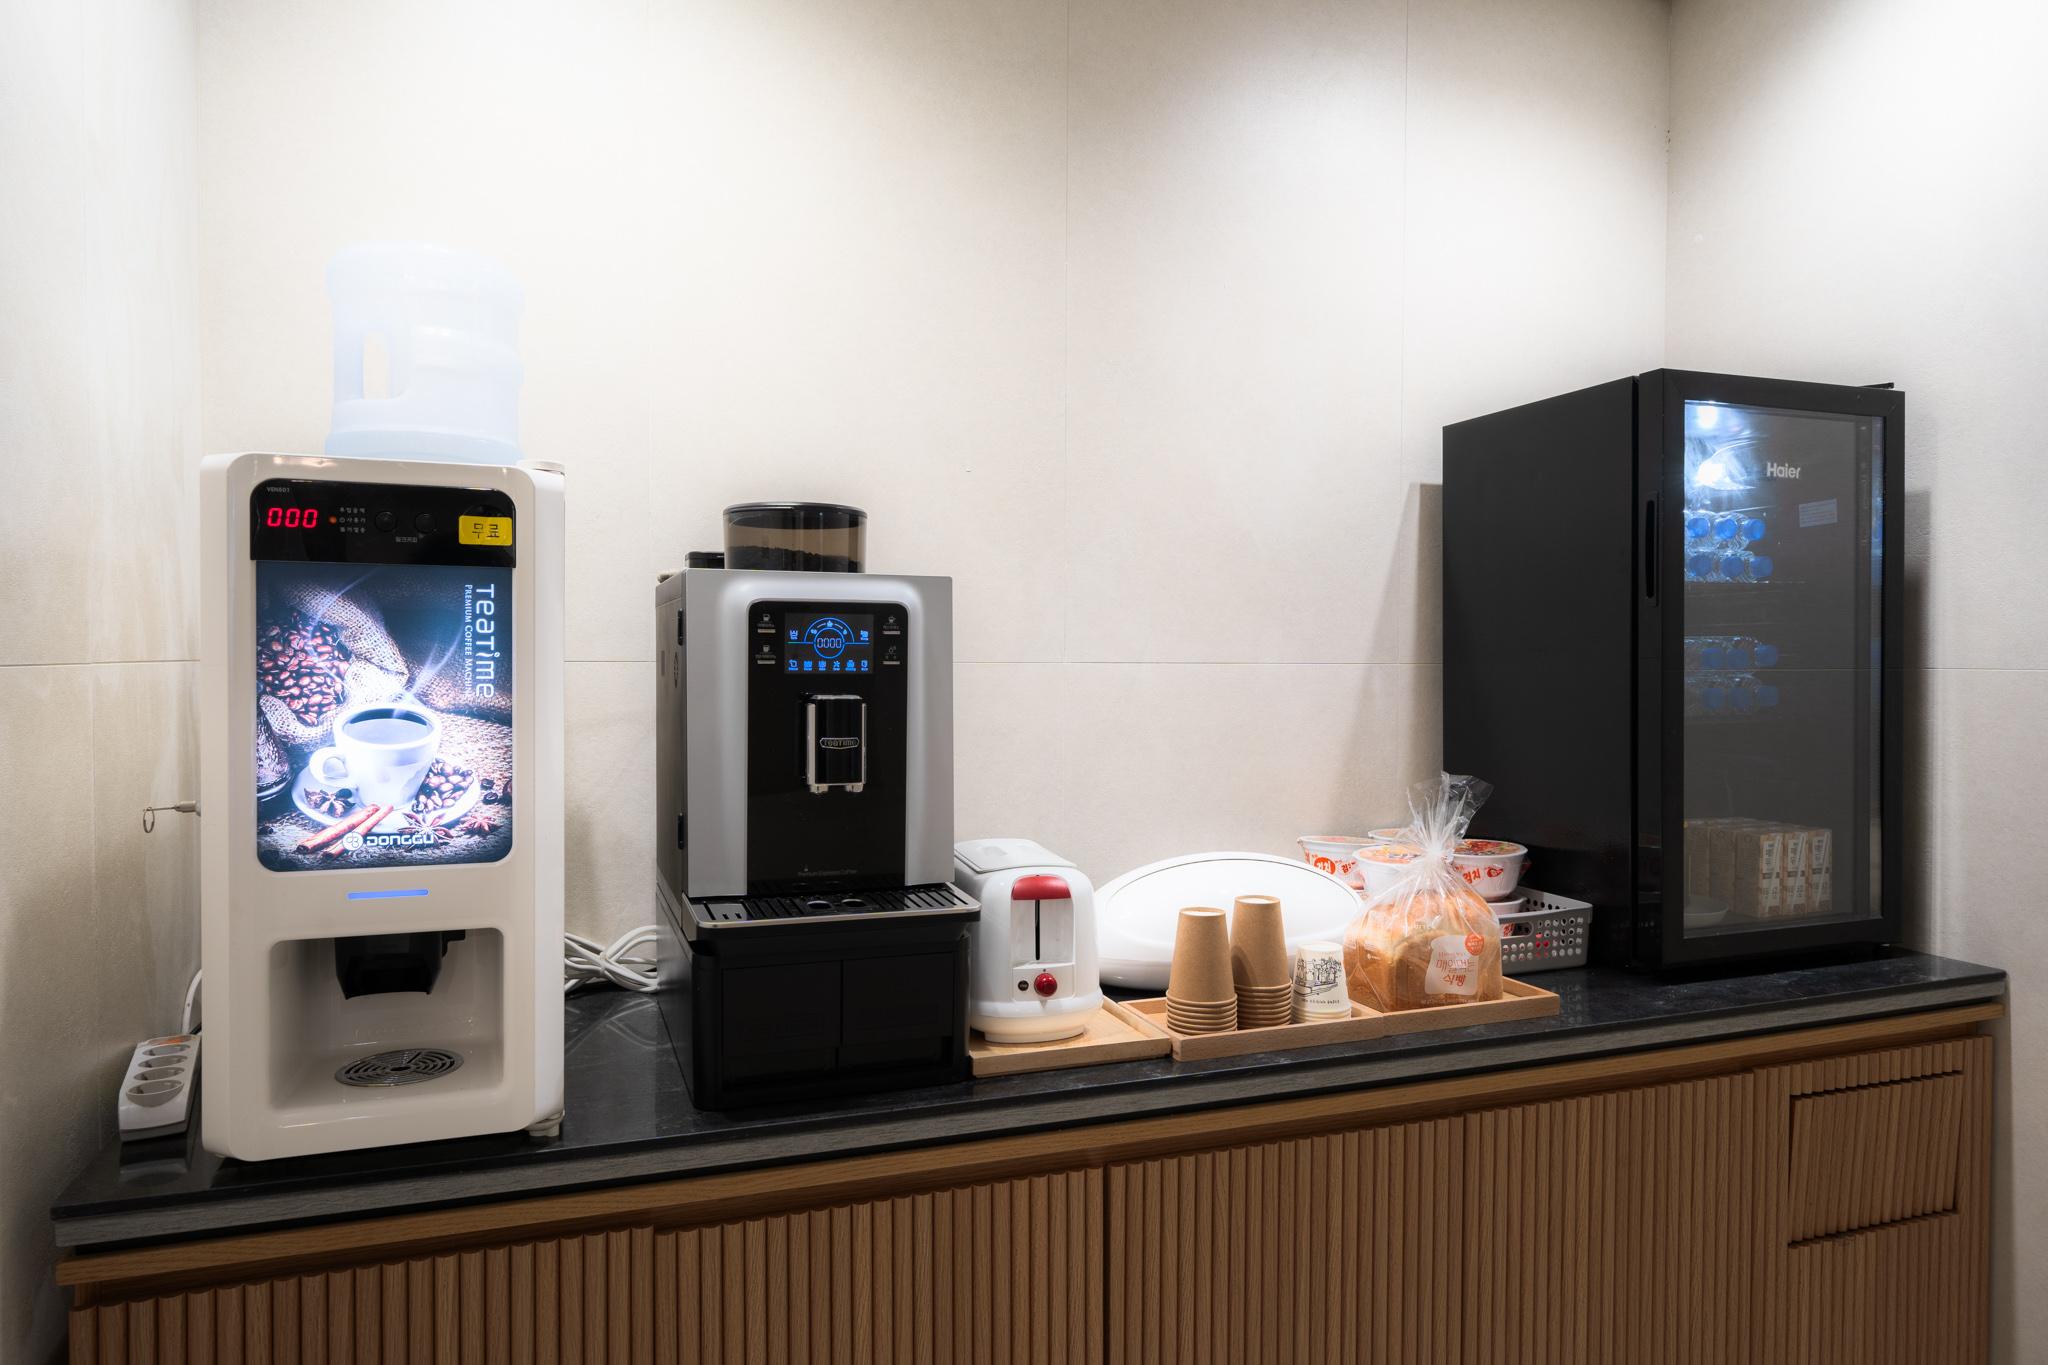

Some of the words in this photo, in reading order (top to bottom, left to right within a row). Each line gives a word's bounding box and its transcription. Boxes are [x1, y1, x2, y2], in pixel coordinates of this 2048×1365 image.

[1766, 462, 1801, 479] Haier
[267, 507, 318, 528] 000
[472, 522, 499, 539] 무료
[816, 637, 842, 649] 0000
[366, 834, 434, 847] DONGGU
